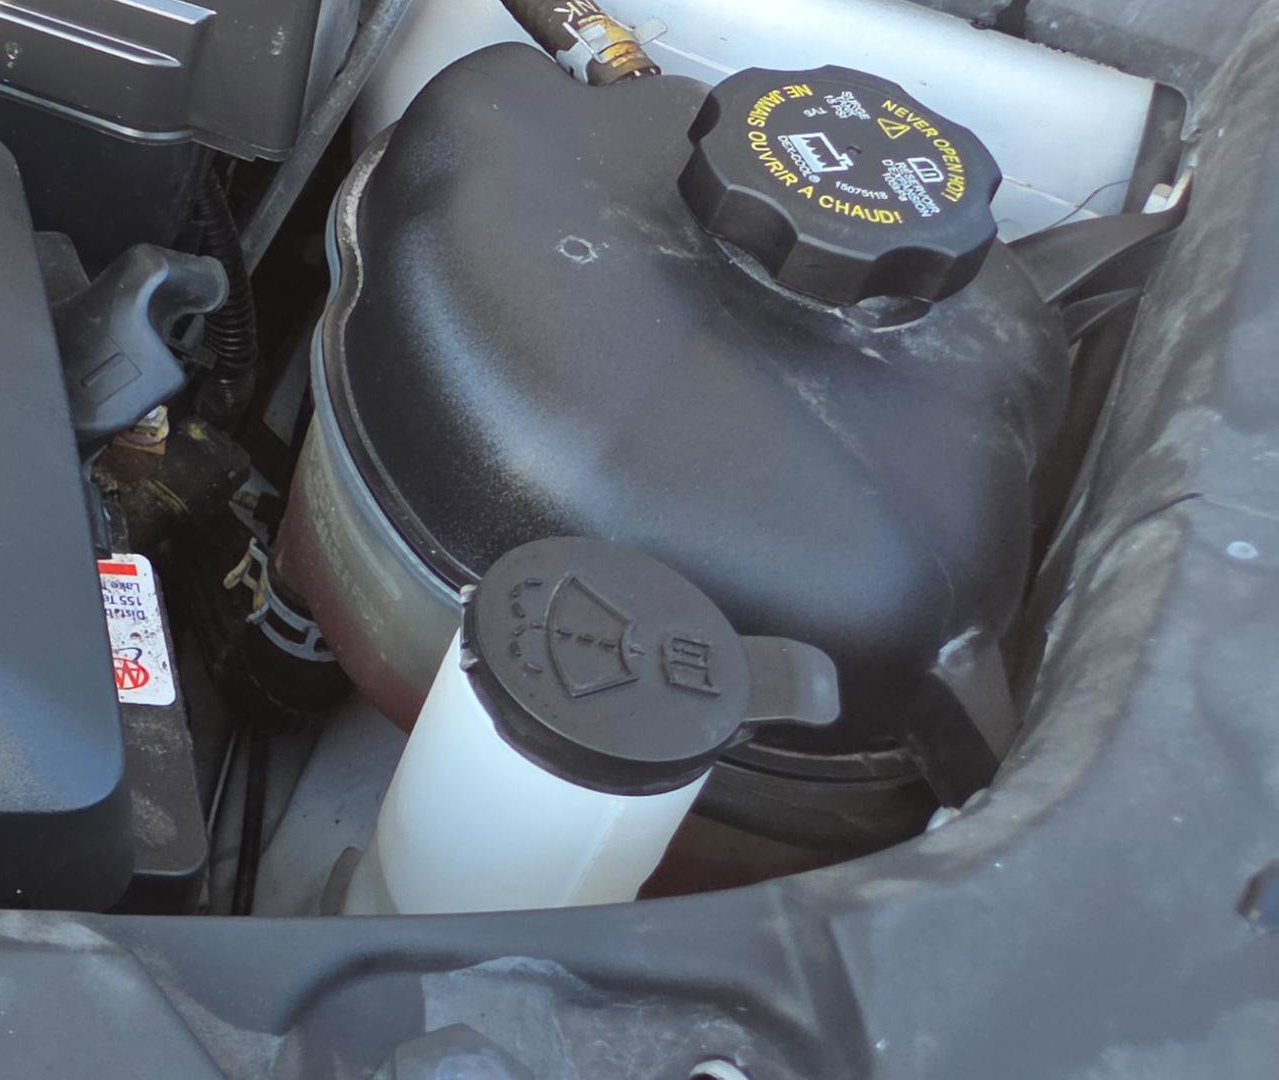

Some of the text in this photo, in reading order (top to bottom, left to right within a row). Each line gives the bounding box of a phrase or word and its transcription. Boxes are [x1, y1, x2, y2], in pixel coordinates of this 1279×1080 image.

[747, 88, 785, 128] JAMAIS
[783, 83, 813, 99] NE
[747, 131, 799, 187] OUVRIR
[881, 100, 964, 202] NEVER OPEN HOT!
[819, 195, 904, 224] CHAUD!
[120, 595, 142, 607] 155
